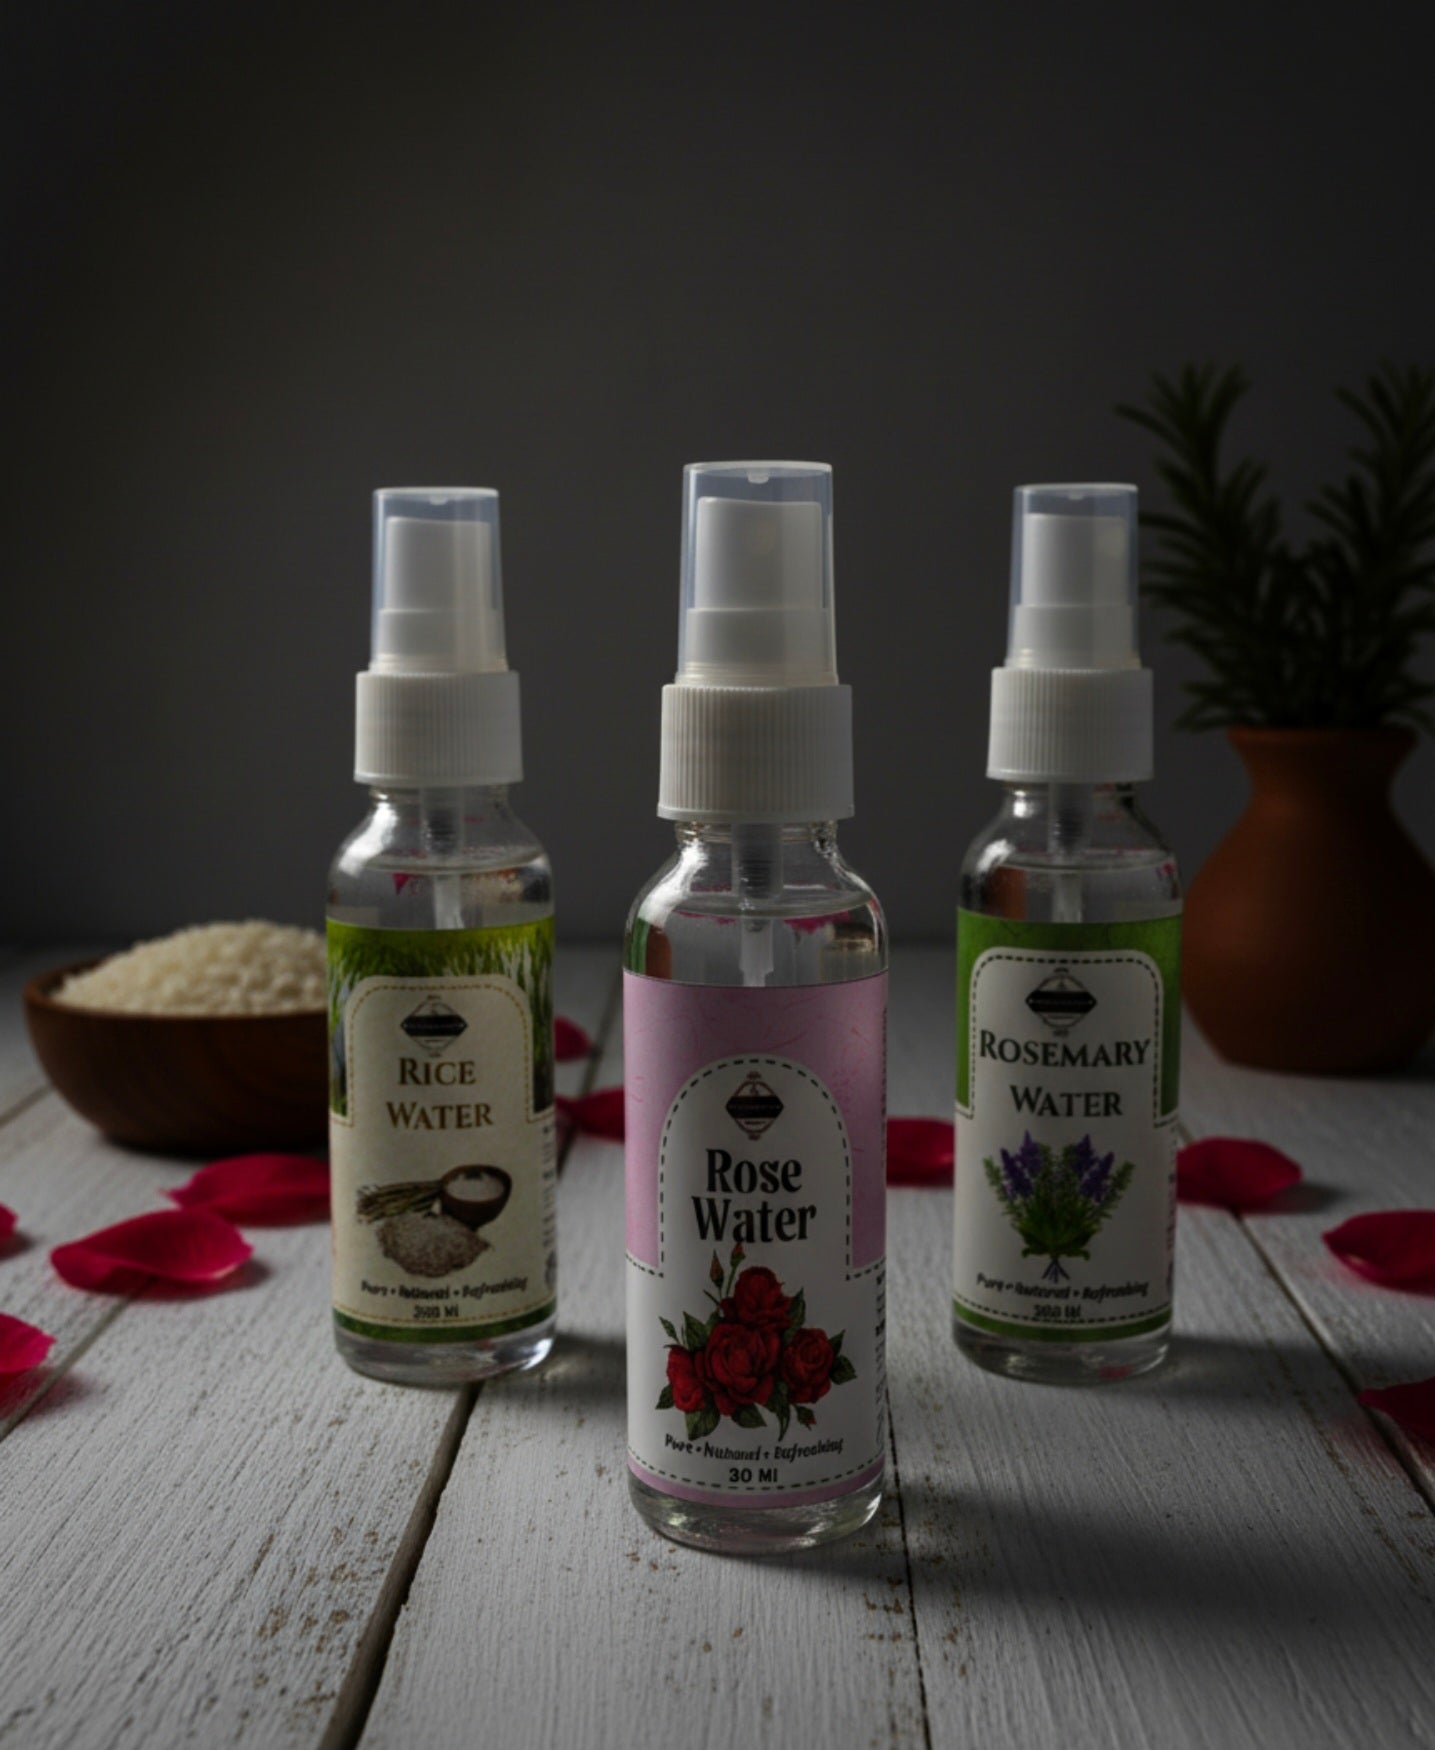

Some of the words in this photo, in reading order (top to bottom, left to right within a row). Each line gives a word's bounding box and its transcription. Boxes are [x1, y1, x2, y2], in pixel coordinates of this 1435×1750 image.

[980, 1030, 1150, 1067] ROSEMARY
[399, 1058, 476, 1085] RICE
[386, 1102, 493, 1130] WATER
[1010, 1085, 1123, 1117] WATER
[706, 1148, 802, 1194] Rose
[691, 1196, 817, 1243] Water
[729, 1468, 752, 1482] 30
